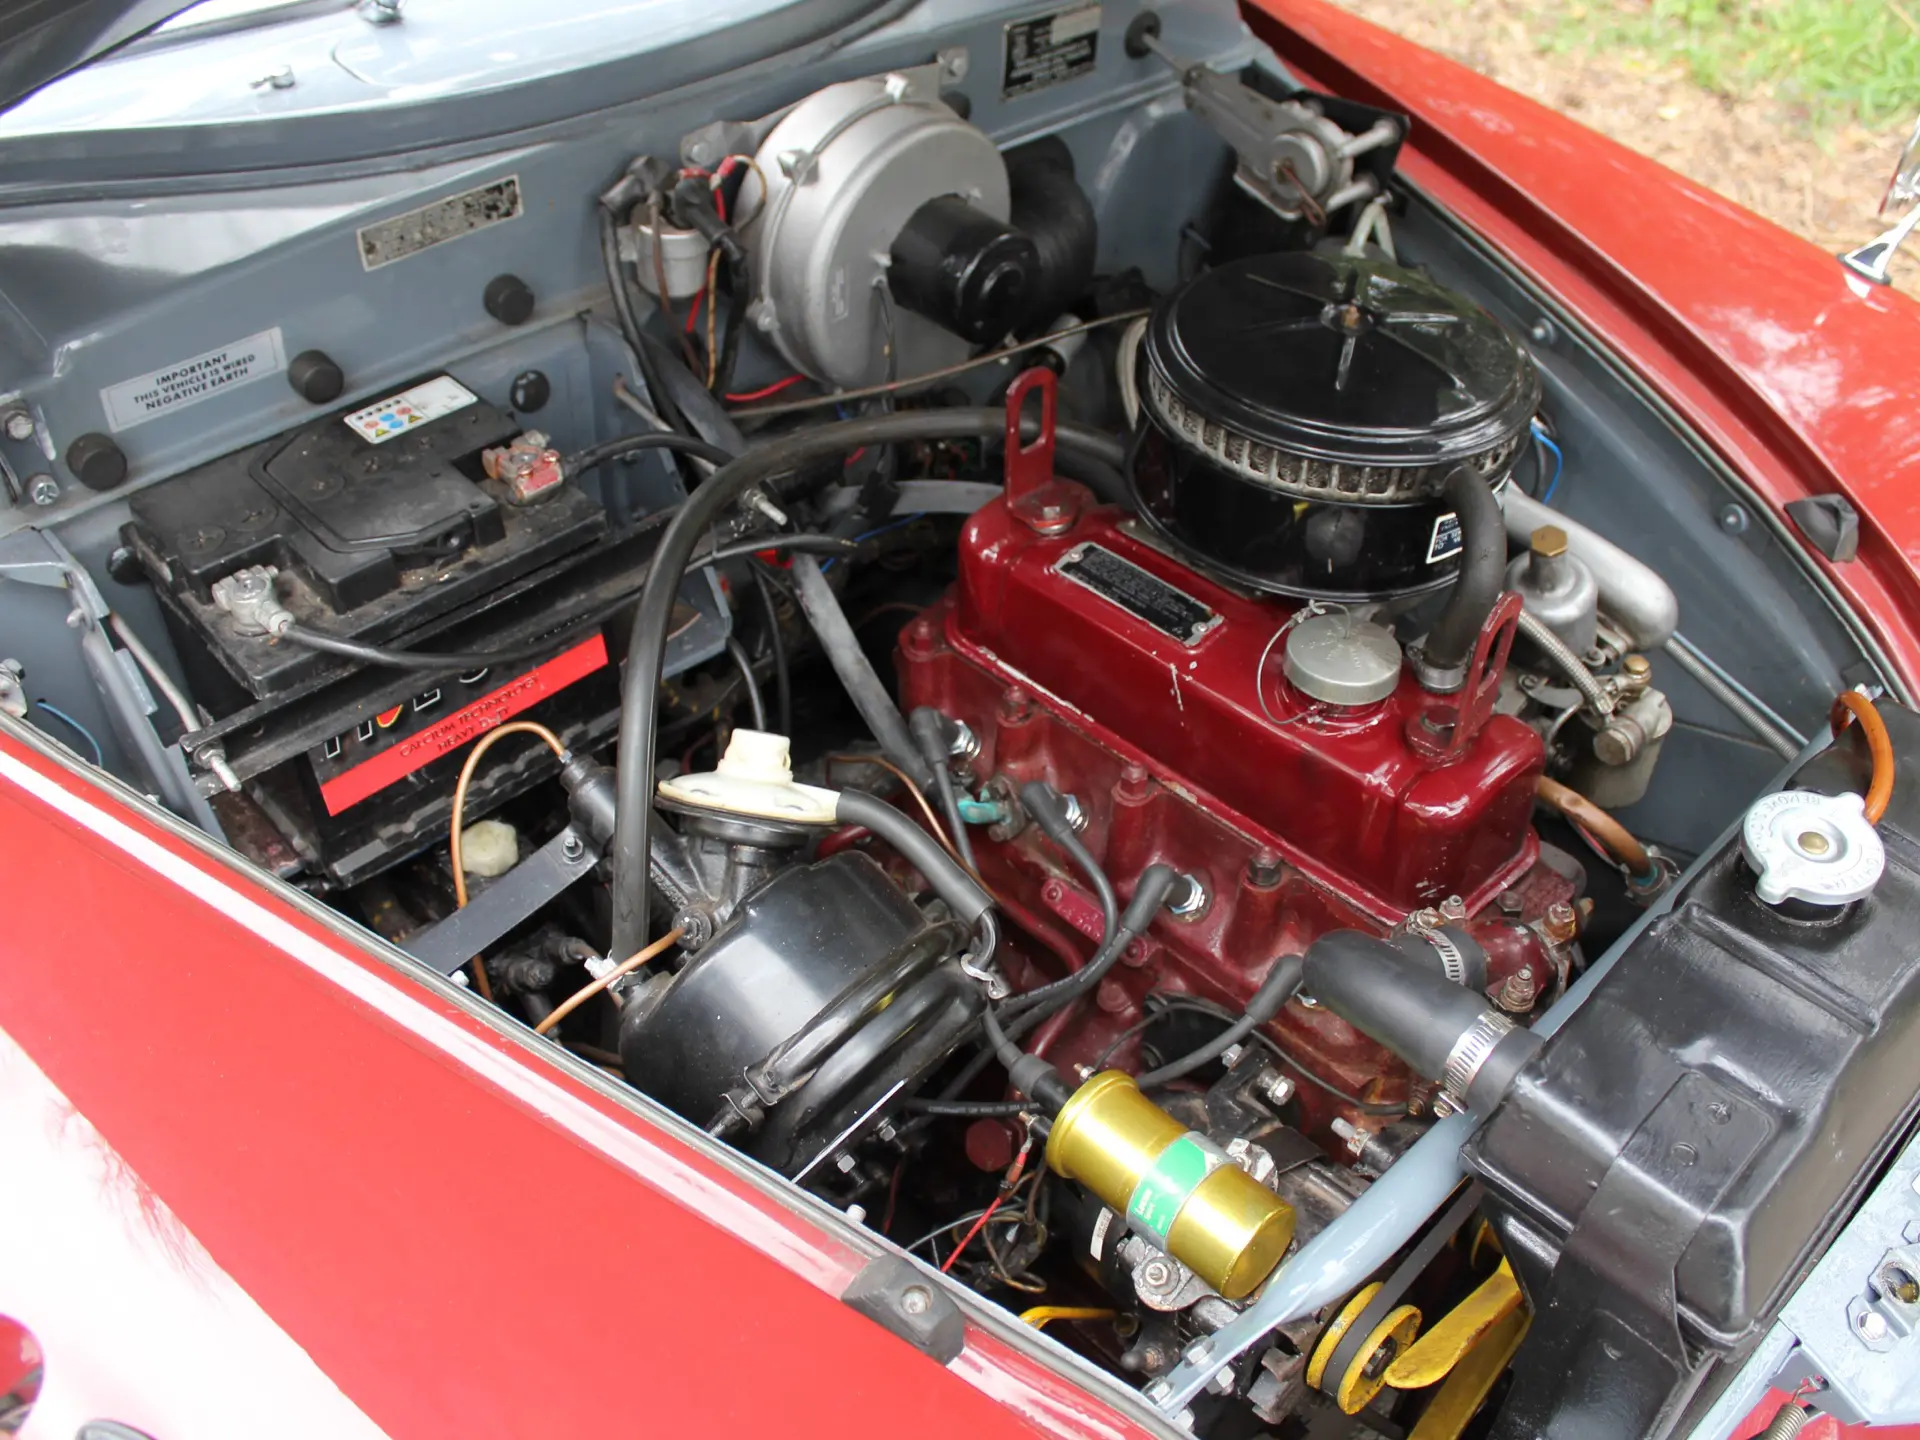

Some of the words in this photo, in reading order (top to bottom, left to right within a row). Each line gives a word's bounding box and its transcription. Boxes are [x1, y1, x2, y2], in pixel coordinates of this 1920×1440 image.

[134, 390, 159, 404] THIS
[162, 373, 207, 394] VEHICLE
[209, 367, 220, 378] IS
[223, 354, 255, 371] WIRED
[145, 383, 208, 411] NEGATIVE
[210, 367, 248, 388] EARTH
[156, 353, 227, 386] IMPORTANT
[400, 720, 456, 757] CALCIUM
[457, 674, 541, 724] TECHNOLOGY
[437, 725, 475, 752] HEAVY
